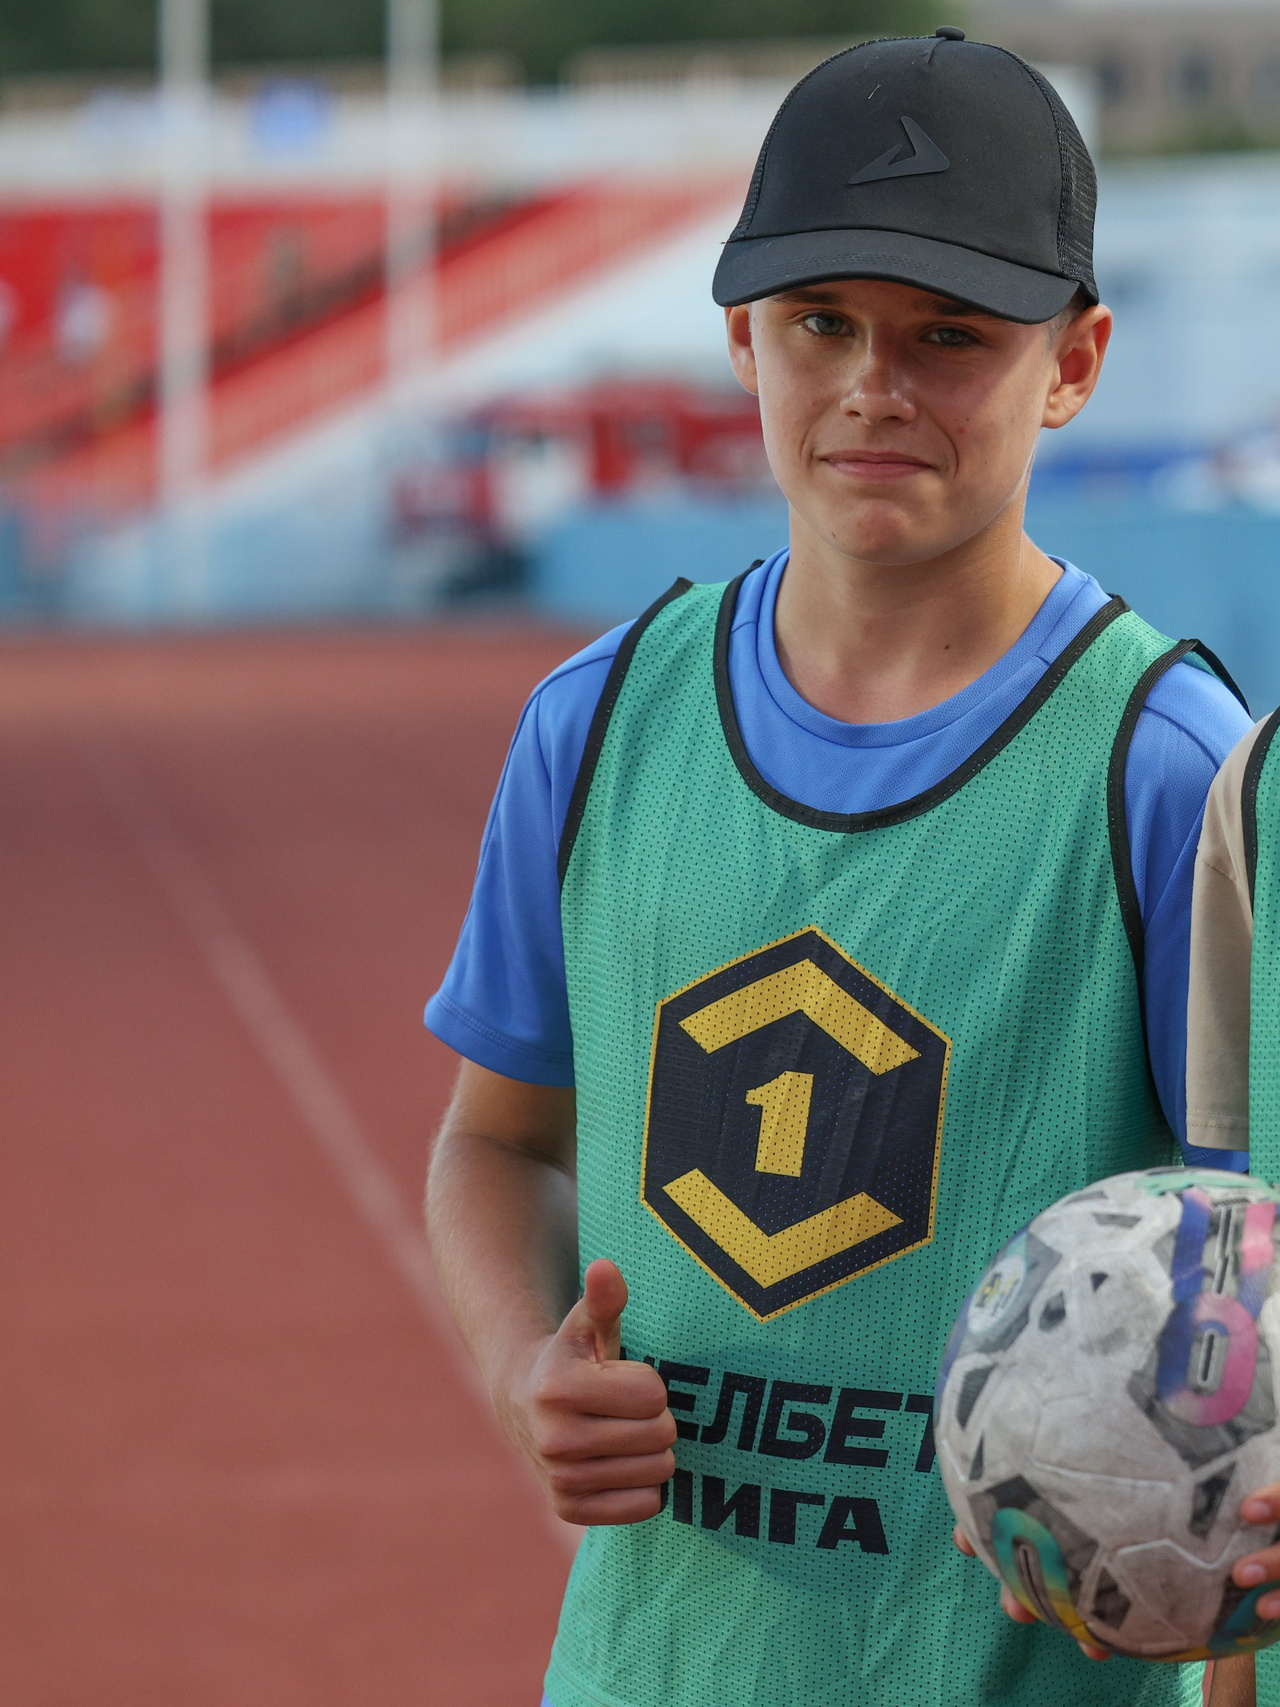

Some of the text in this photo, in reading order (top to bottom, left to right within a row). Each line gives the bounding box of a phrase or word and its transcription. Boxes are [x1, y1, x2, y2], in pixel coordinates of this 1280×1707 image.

[745, 1070, 814, 1178] 1
[619, 1346, 936, 1473] ЕЛБЕТ
[659, 1468, 889, 1555] ЛИГА
